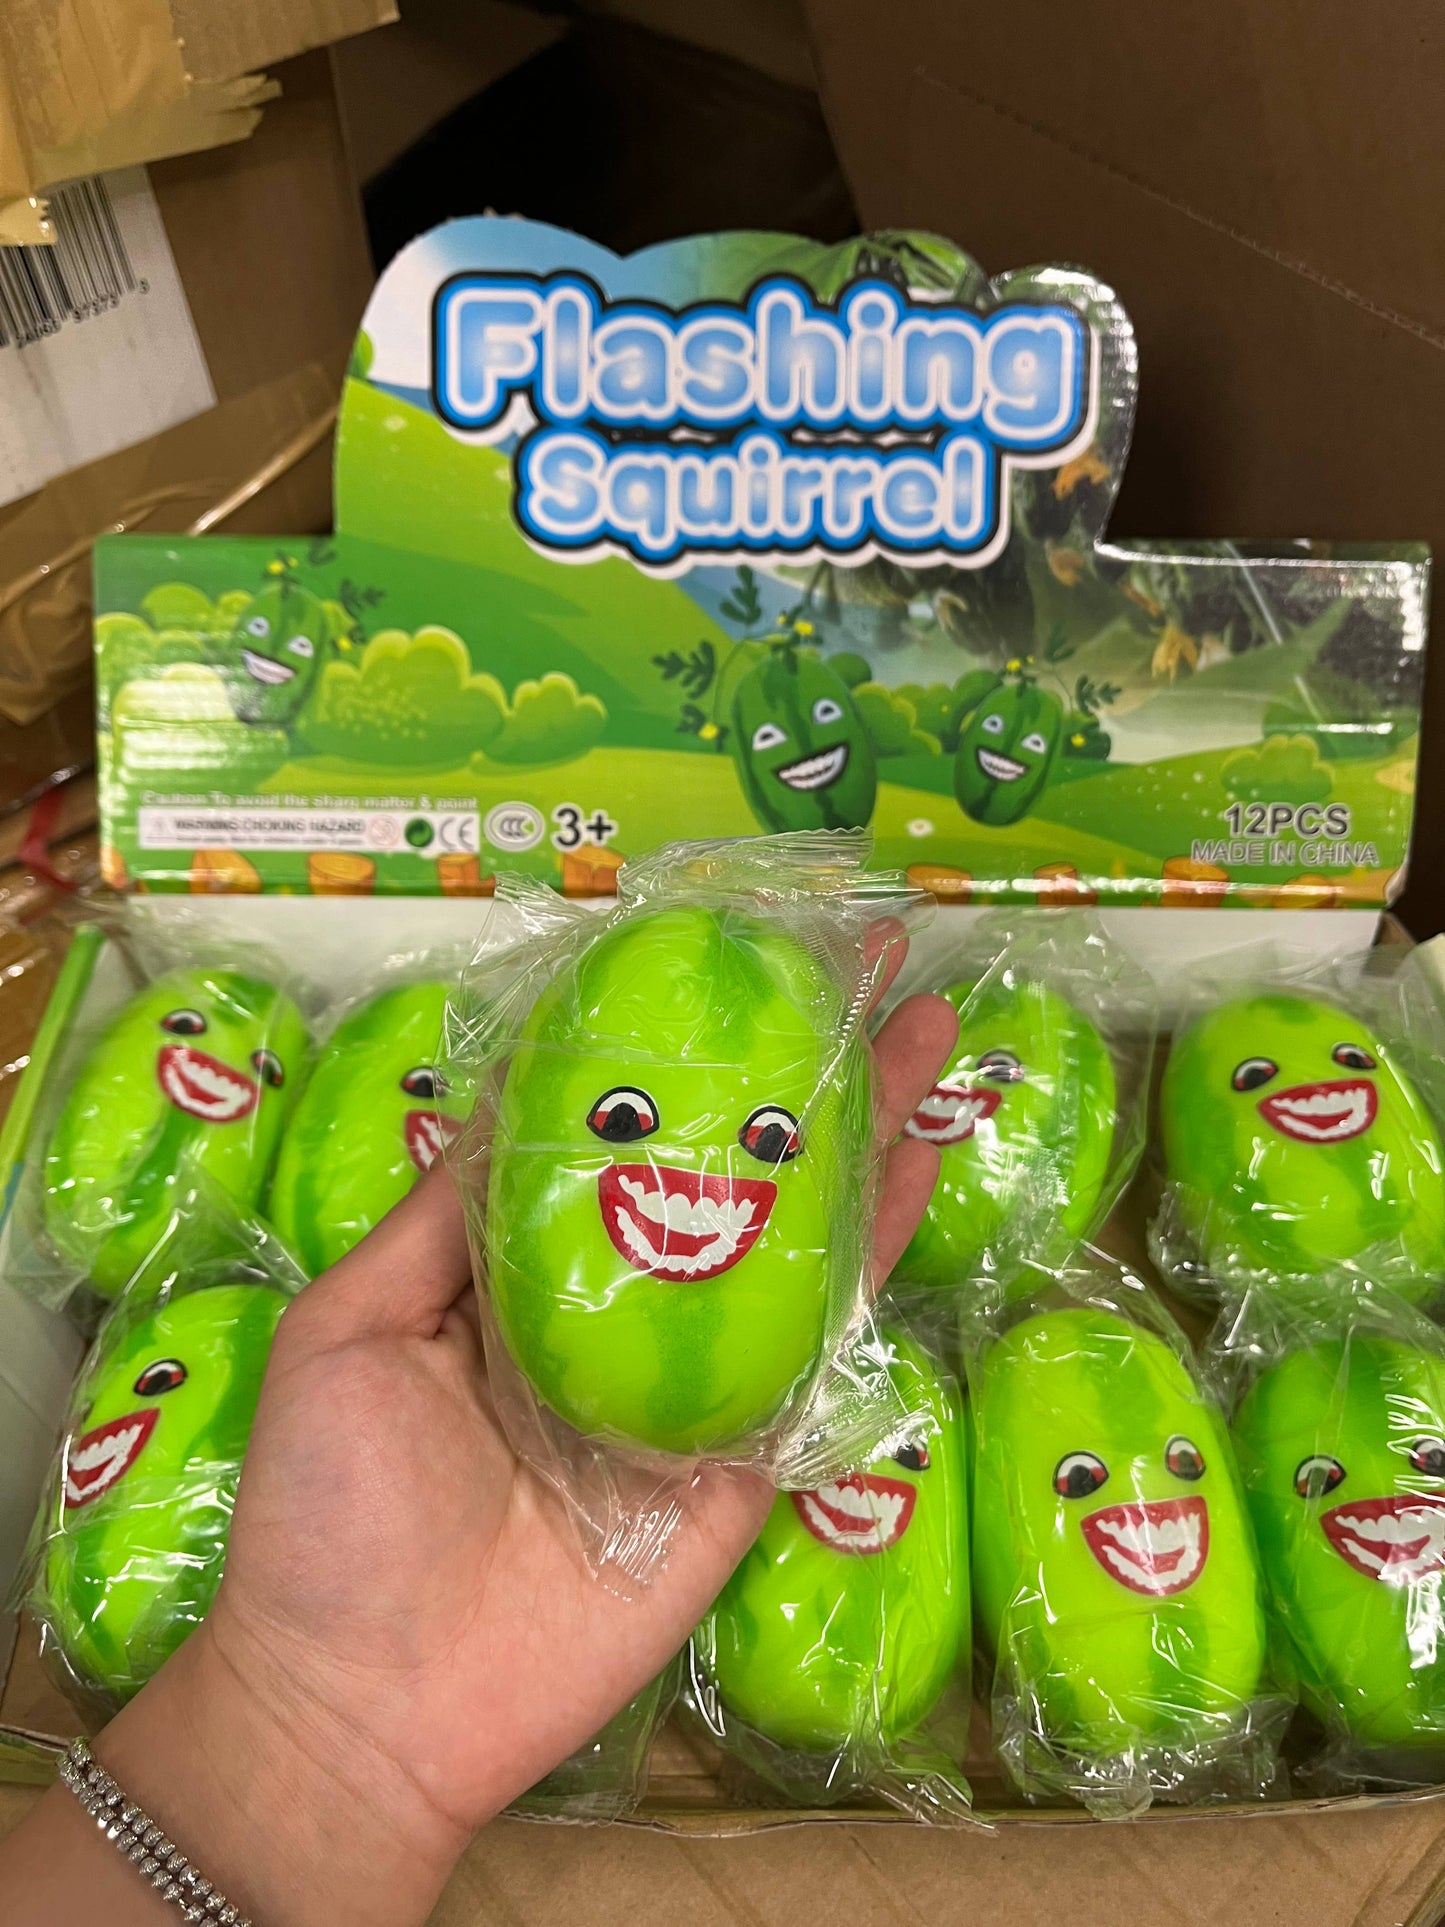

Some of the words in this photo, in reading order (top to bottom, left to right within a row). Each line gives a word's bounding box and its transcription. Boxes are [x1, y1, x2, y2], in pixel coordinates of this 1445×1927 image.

[441, 279, 1088, 446] Flashing
[520, 427, 999, 557] Squirrel
[555, 805, 615, 849] 3+
[1224, 802, 1350, 839] 12PCS
[1191, 838, 1266, 866] MADE
[1270, 840, 1296, 866] IN
[1300, 840, 1381, 868] CHINA
